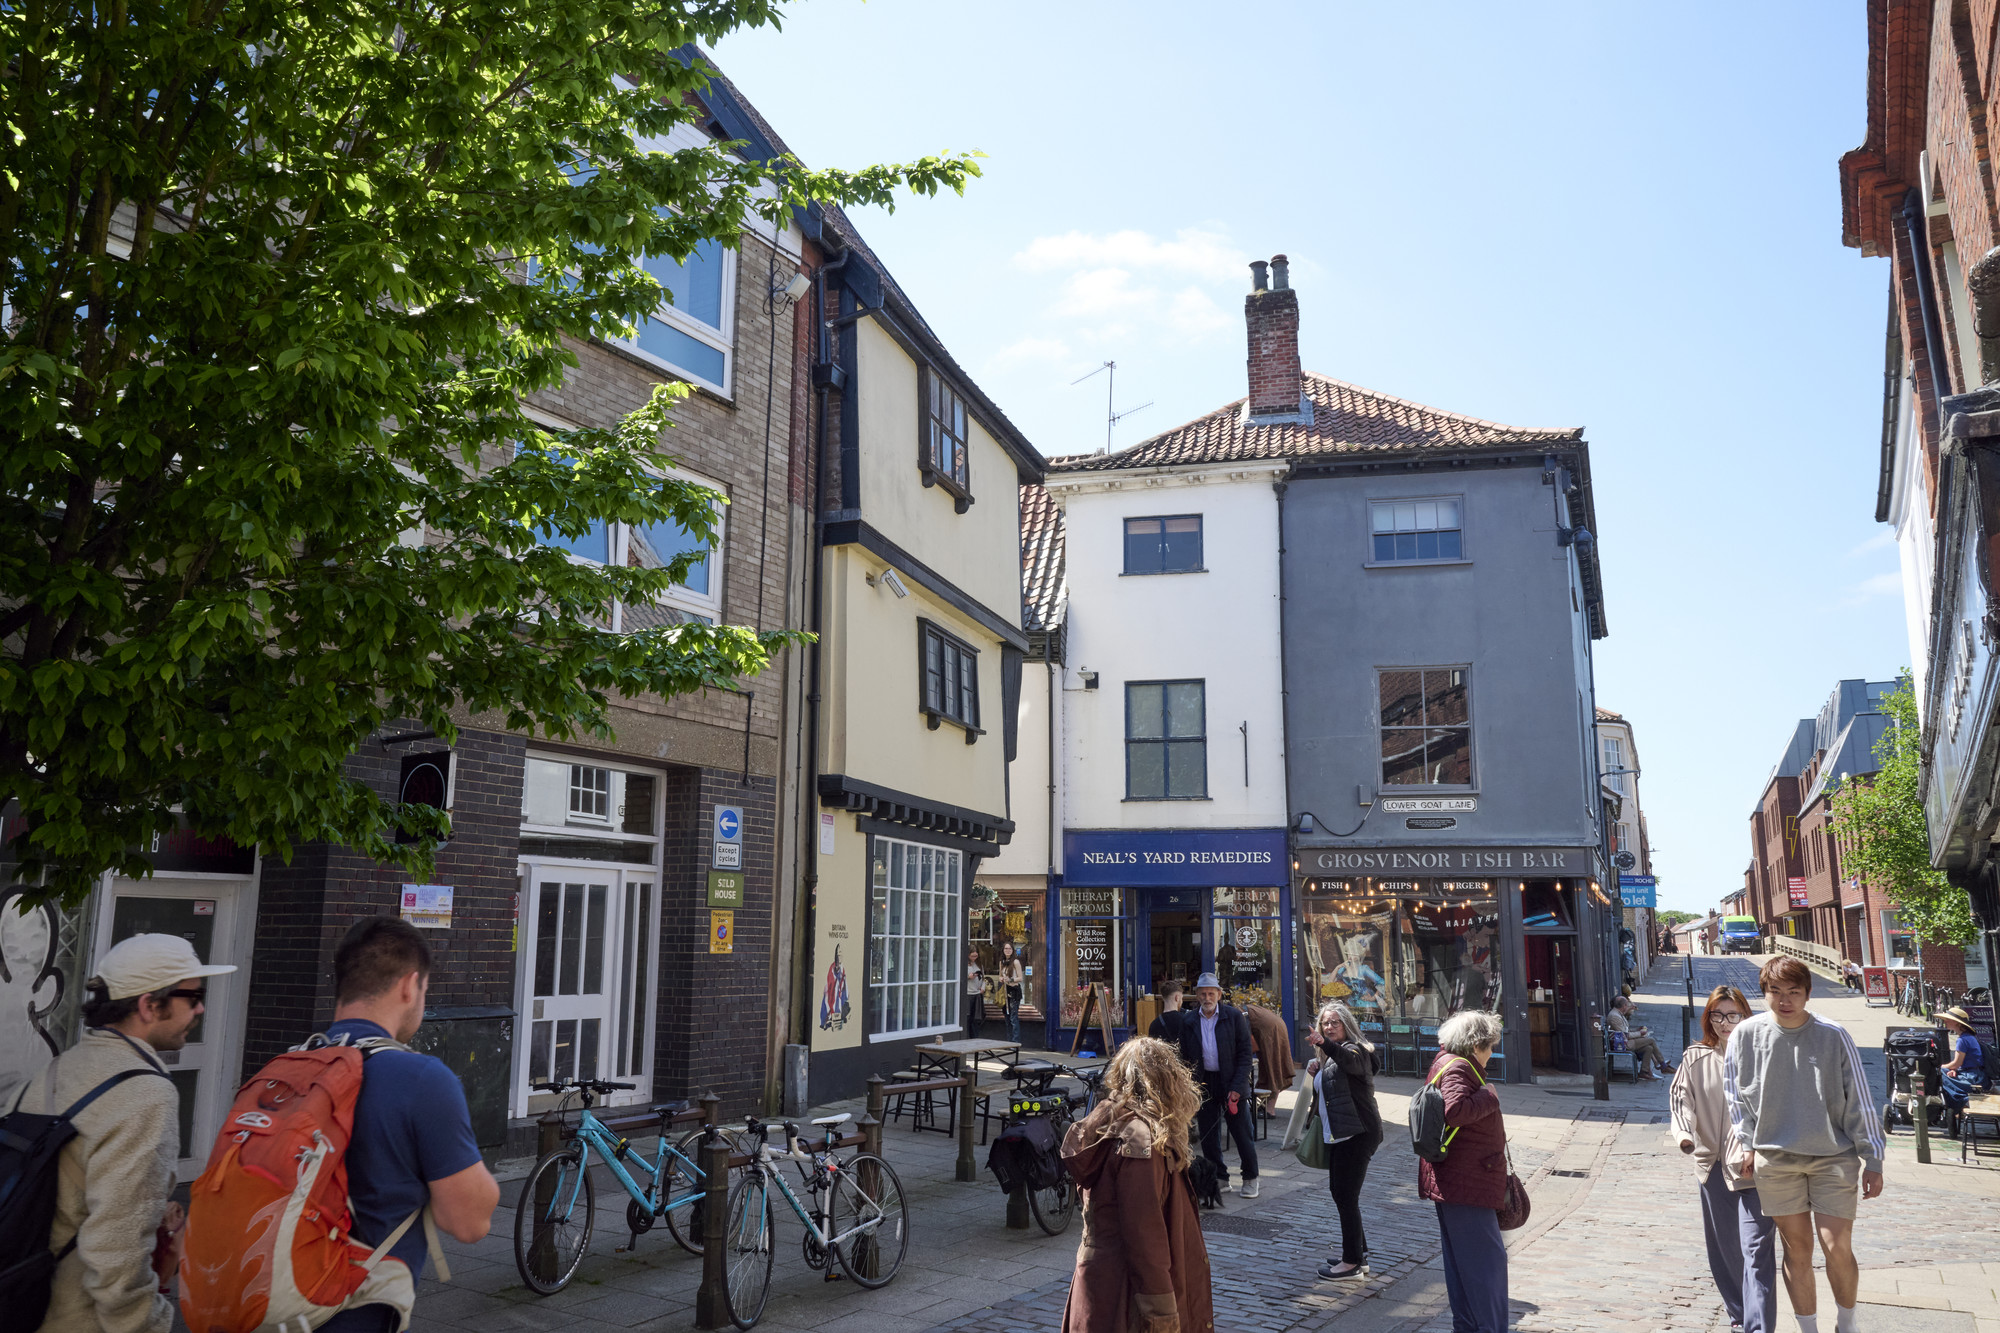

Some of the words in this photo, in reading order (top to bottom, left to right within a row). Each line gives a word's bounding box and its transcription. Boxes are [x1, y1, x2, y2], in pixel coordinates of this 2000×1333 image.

[1386, 801, 1416, 809] LOWER
[1421, 801, 1443, 809] GOAT
[1448, 801, 1472, 809] LANE
[717, 845, 737, 855] Except
[718, 854, 737, 863] cycles
[1083, 851, 1137, 865] NEAL'S
[1142, 851, 1185, 865] YARD
[1189, 851, 1272, 865] REMEDIES
[1317, 852, 1451, 869] GROSVENOR
[1461, 852, 1513, 868] FISH
[1522, 852, 1566, 868] BAR
[1321, 882, 1344, 890] FISH
[1384, 882, 1412, 890] CHIPS
[714, 889, 737, 900] HOUSE
[1066, 891, 1116, 901] THERAPY
[1169, 895, 1179, 903] 26
[1632, 895, 1647, 905] let
[1072, 903, 1111, 913] ROOMS
[1227, 902, 1267, 913] ROOMS
[412, 916, 439, 924] WINNER
[1075, 947, 1106, 961] 90%
[1972, 1009, 1993, 1017] Saint
